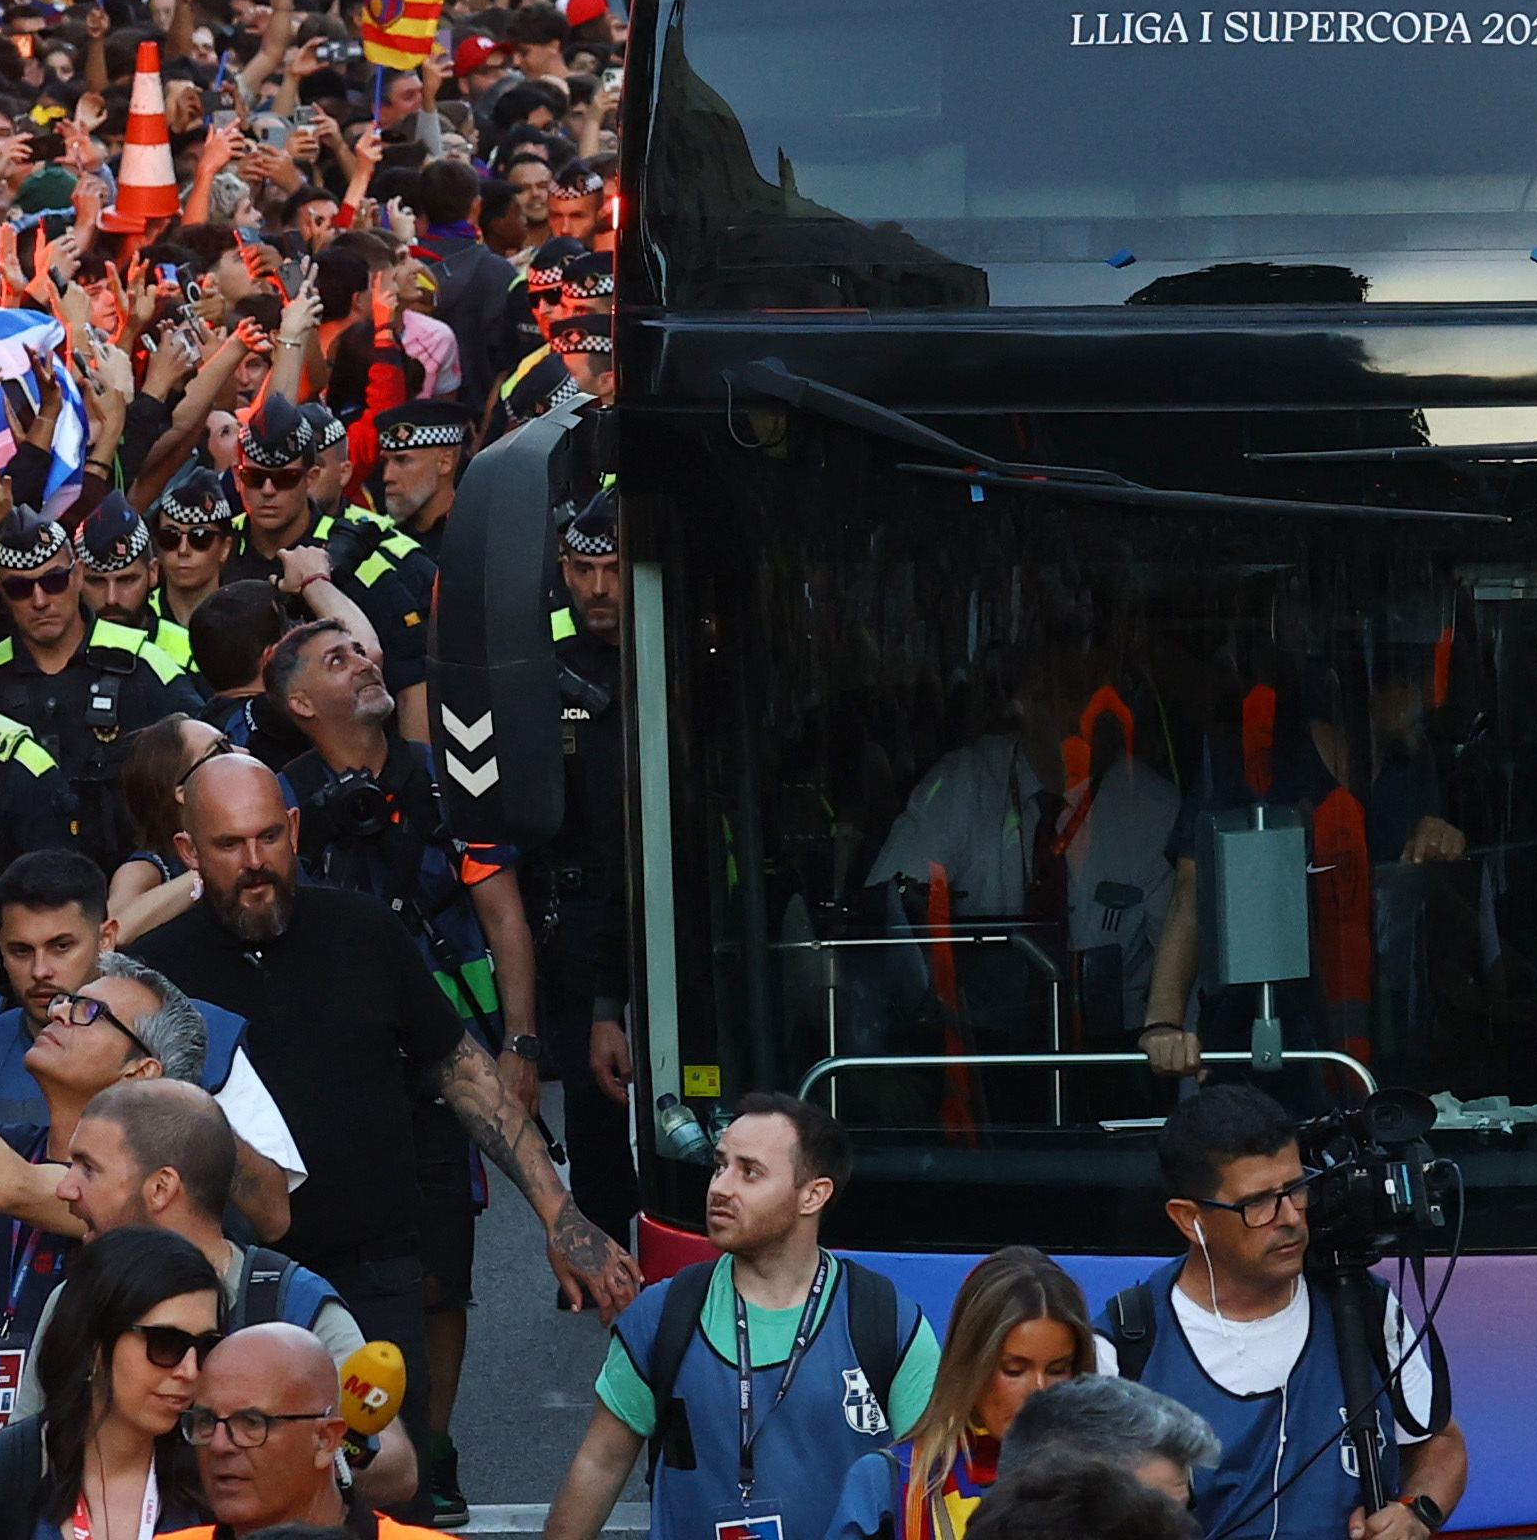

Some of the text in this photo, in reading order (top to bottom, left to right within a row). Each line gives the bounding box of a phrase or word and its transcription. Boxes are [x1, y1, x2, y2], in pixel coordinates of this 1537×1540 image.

[1069, 13, 1190, 47] LLIGA
[1199, 11, 1214, 45] I
[1223, 10, 1473, 46] SUPERCOPA
[344, 1374, 390, 1409] MD
